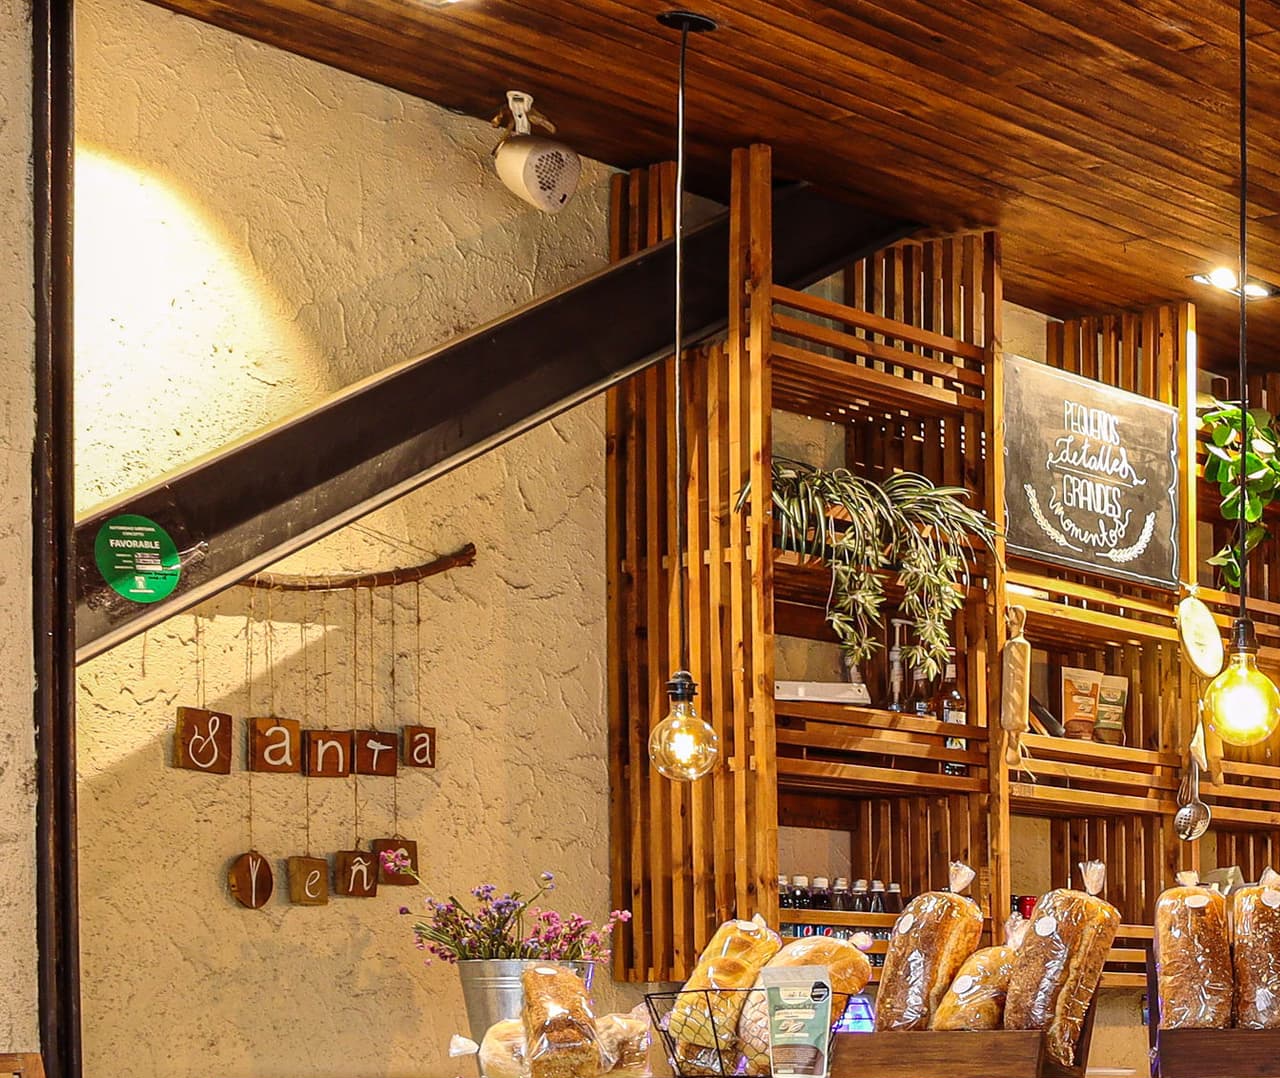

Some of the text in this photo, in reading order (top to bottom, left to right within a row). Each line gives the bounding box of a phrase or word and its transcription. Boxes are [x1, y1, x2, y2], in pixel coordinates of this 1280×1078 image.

[1049, 486, 1133, 548] momentos
[1063, 474, 1122, 519] GRANDES
[109, 538, 160, 549] FAVORABLE
[188, 716, 432, 773] Santa
